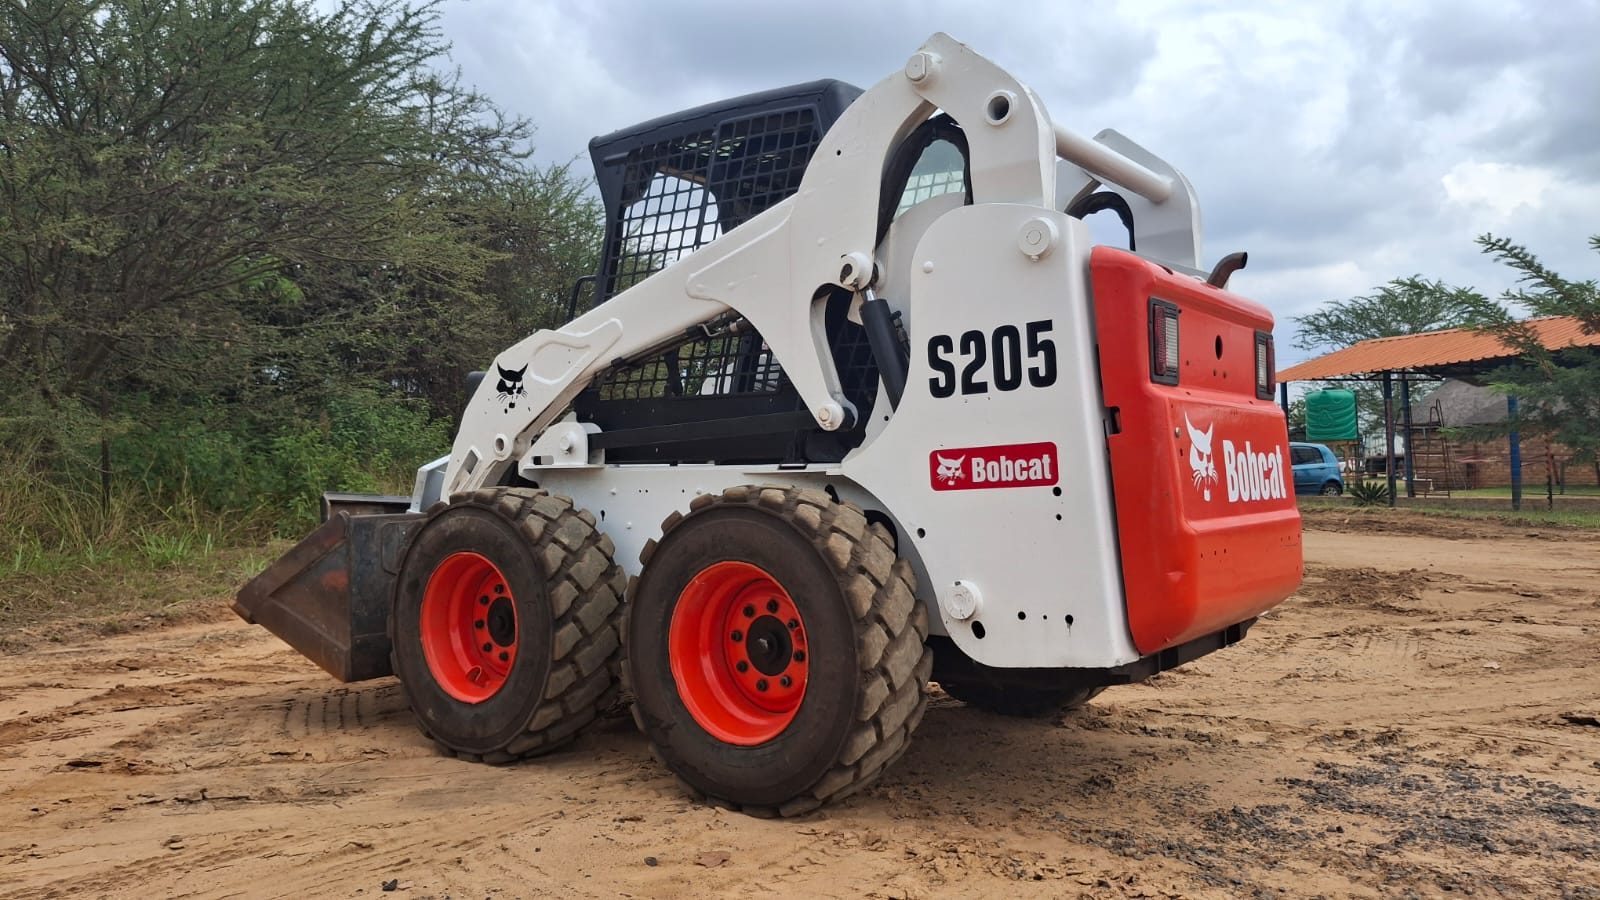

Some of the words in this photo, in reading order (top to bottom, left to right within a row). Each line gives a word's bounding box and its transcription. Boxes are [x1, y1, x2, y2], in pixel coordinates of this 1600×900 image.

[927, 319, 1057, 398] S205
[971, 455, 1052, 482] Bobcat
[1223, 440, 1286, 502] Bobcat
